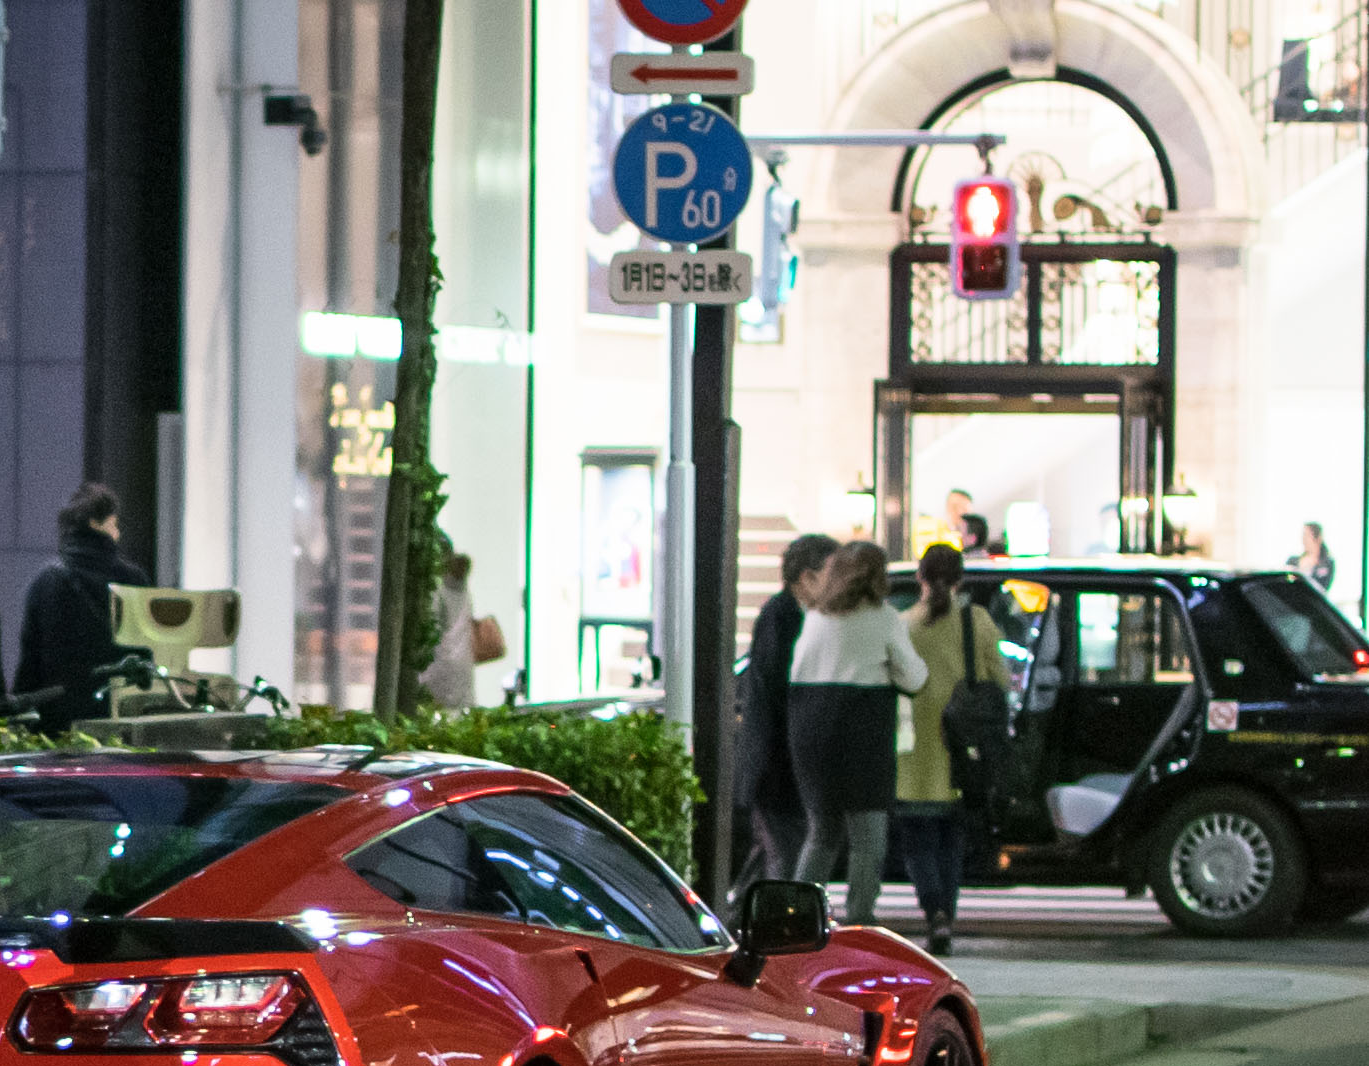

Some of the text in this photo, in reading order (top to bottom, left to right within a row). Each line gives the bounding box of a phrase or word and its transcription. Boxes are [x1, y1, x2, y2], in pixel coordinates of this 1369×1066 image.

[652, 109, 716, 135] 9-21
[645, 141, 698, 228] P
[682, 188, 722, 229] 60
